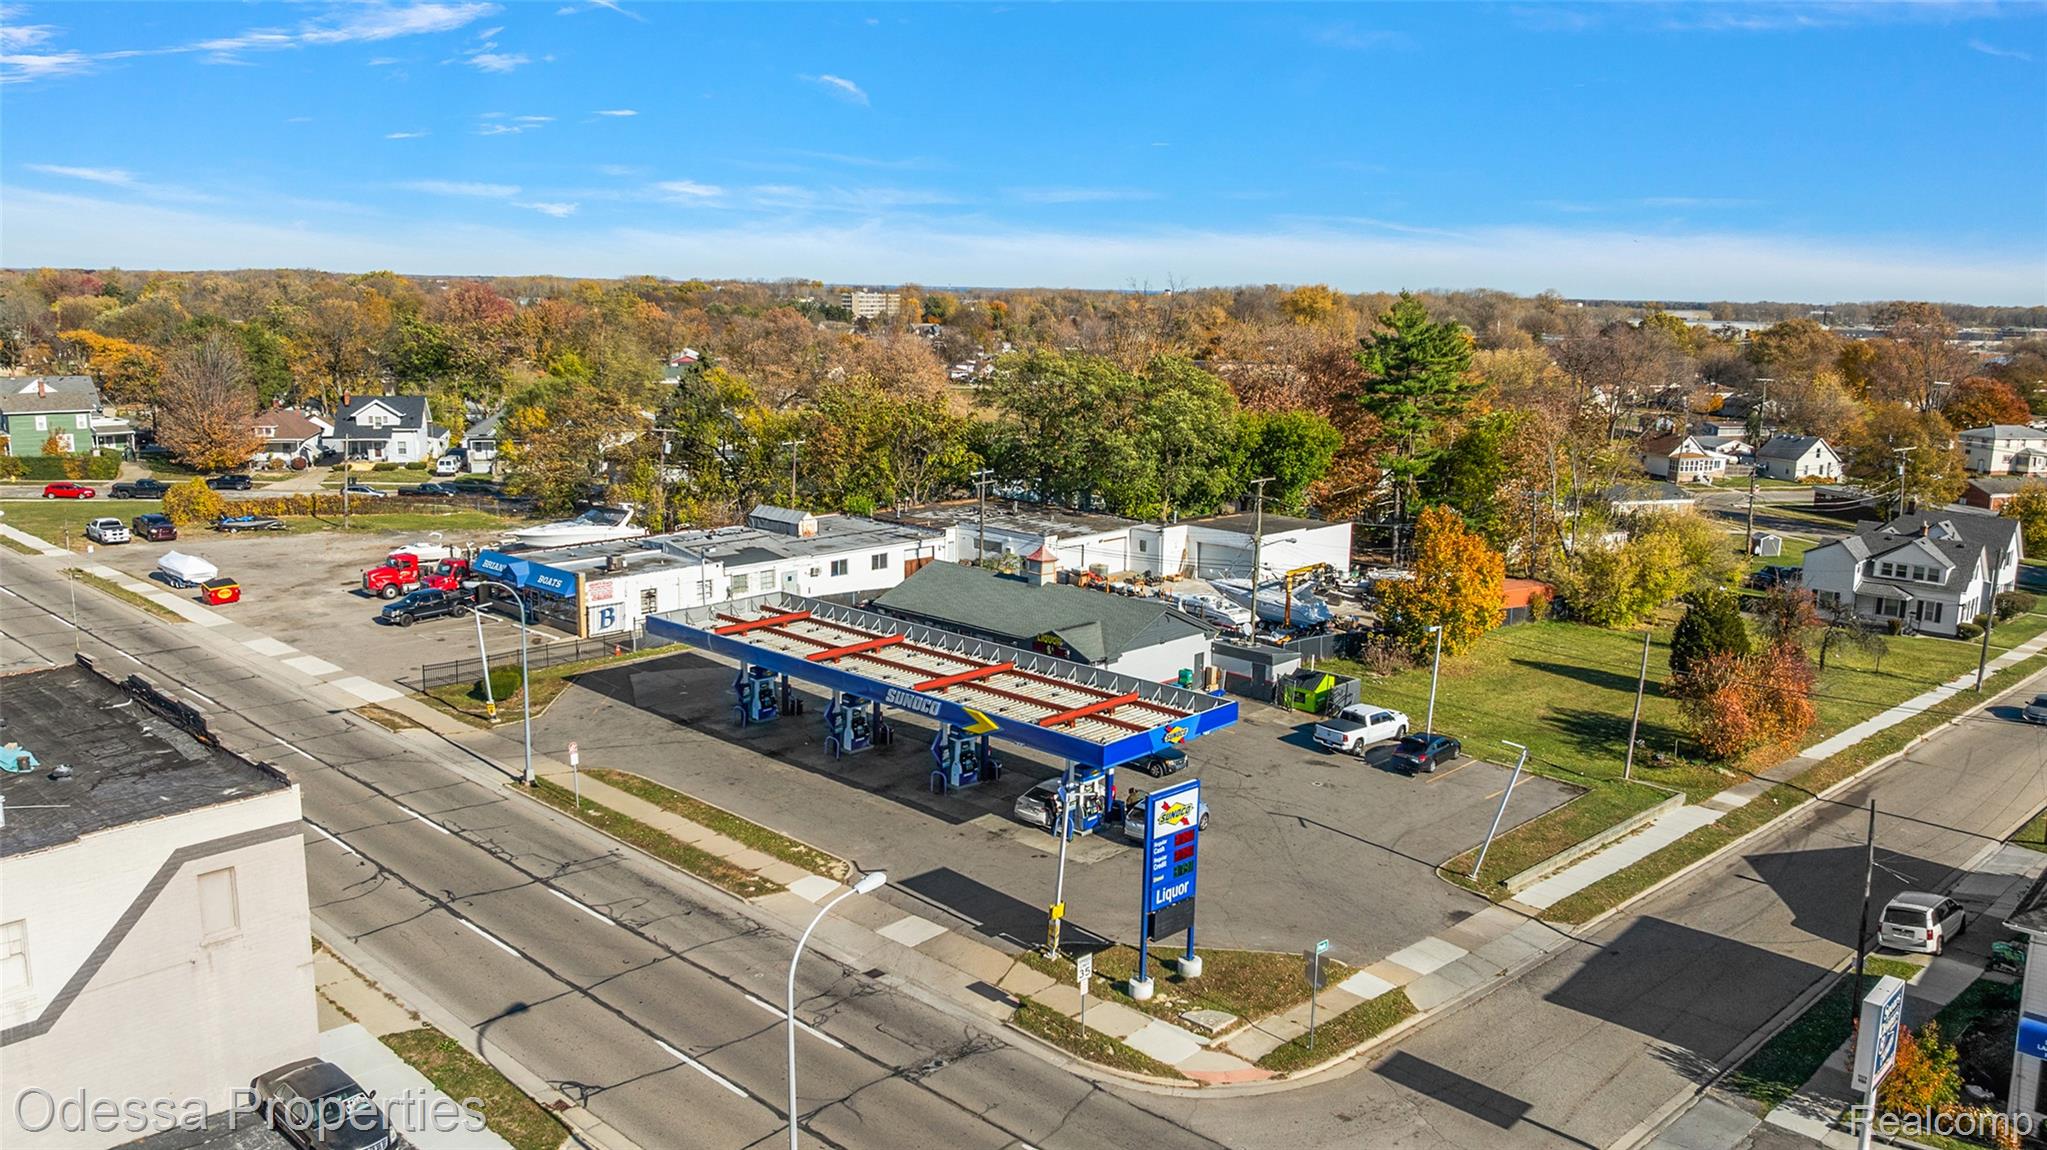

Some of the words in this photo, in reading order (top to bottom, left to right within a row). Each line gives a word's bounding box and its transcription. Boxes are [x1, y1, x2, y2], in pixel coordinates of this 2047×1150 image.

[537, 575, 563, 588] BOATS
[599, 607, 615, 631] B
[885, 688, 942, 716] SUNOCO
[1158, 803, 1194, 825] SUNOCO
[1155, 881, 1190, 904] Liquor
[1079, 966, 1091, 979] 35
